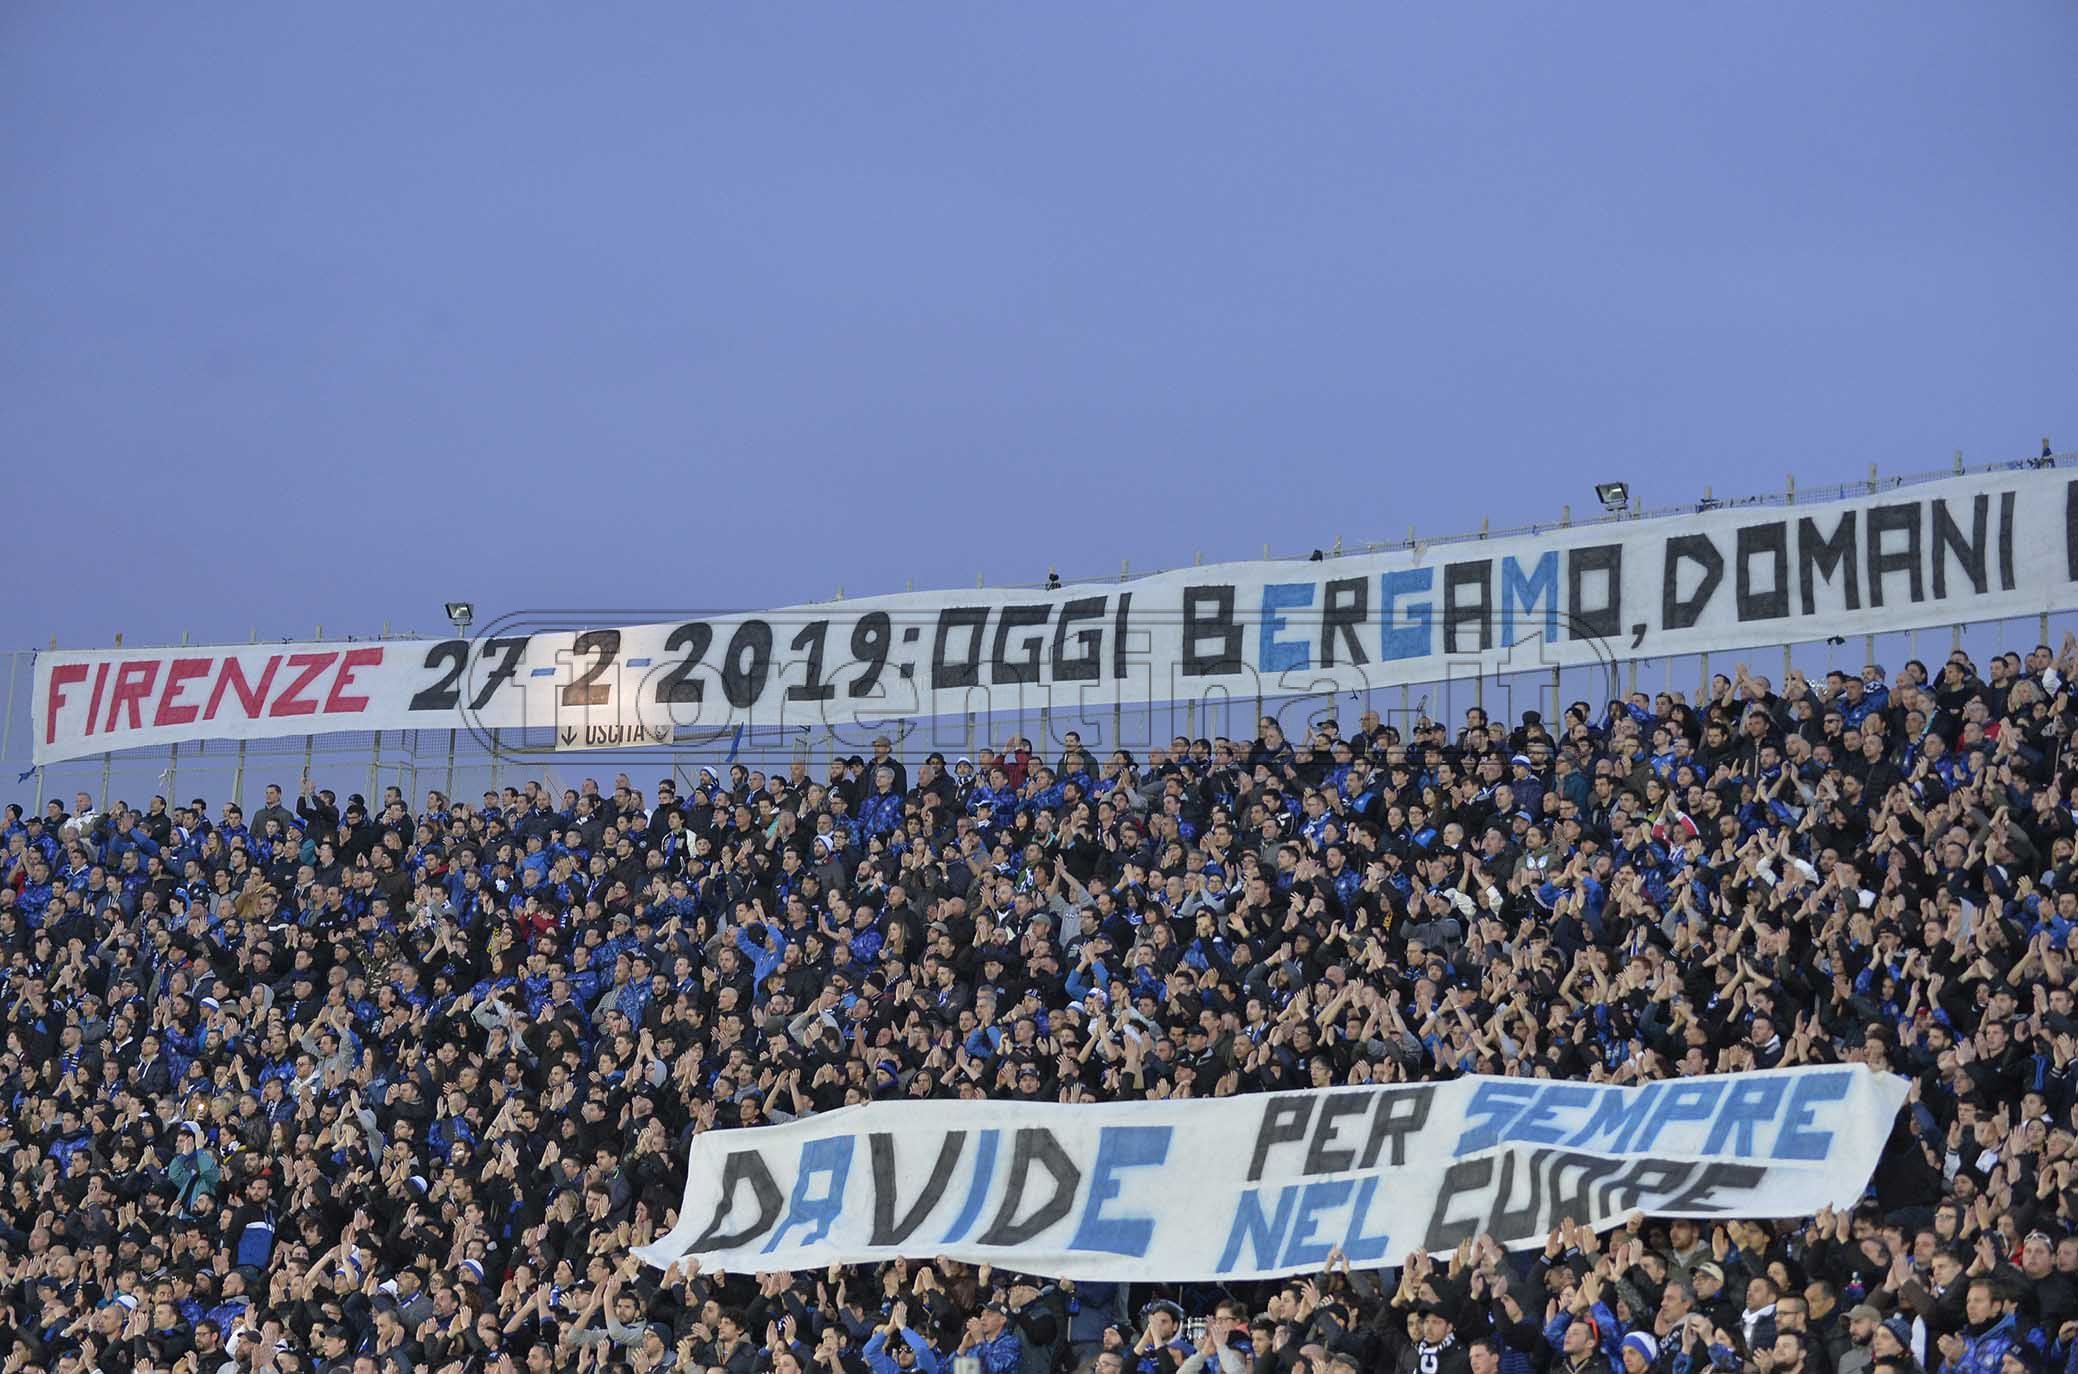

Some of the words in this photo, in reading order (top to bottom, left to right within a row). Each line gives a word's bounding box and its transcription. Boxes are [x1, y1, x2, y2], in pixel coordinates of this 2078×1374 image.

[46, 647, 384, 744] FIRENZE
[1662, 491, 2016, 630] DOMANI
[585, 724, 645, 745] USCITA
[1246, 1086, 1435, 1181] PER
[1453, 1071, 1854, 1161] SEMPRE
[681, 1125, 1174, 1258] DAVIDE
[1216, 1175, 1389, 1274] NEL
[1423, 1147, 1768, 1251] CUORE
